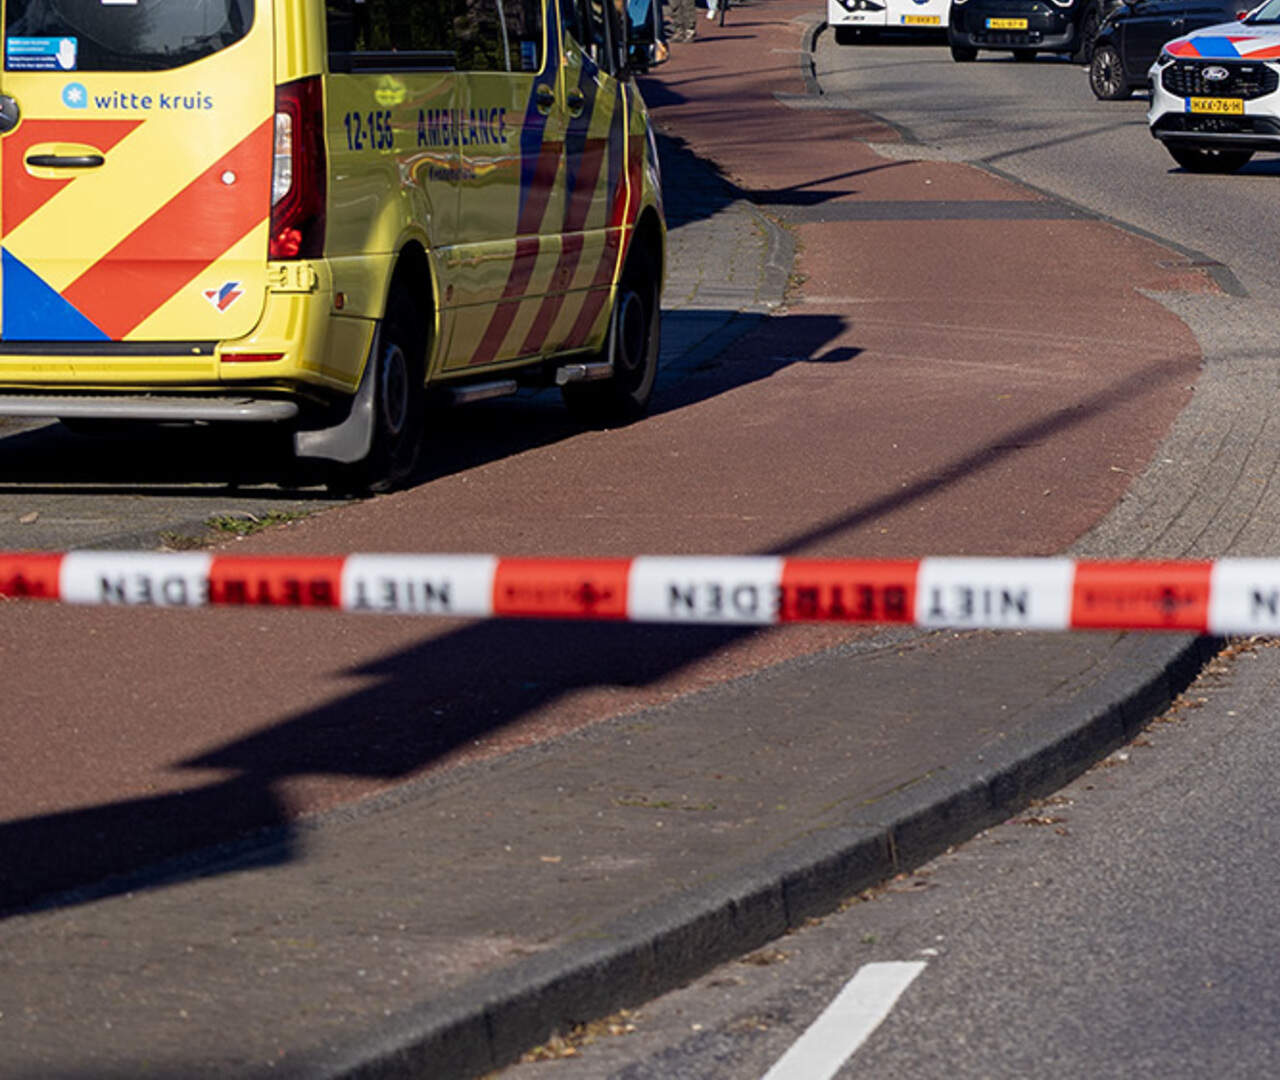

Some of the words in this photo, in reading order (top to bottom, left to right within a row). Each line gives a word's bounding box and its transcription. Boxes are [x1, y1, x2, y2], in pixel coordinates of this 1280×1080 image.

[94, 91, 152, 110] witte
[159, 91, 214, 110] kruis
[344, 109, 394, 151] 12-156
[417, 107, 508, 147] AMBULANCE
[353, 577, 453, 611] NIET
[928, 584, 1031, 620] NIET
